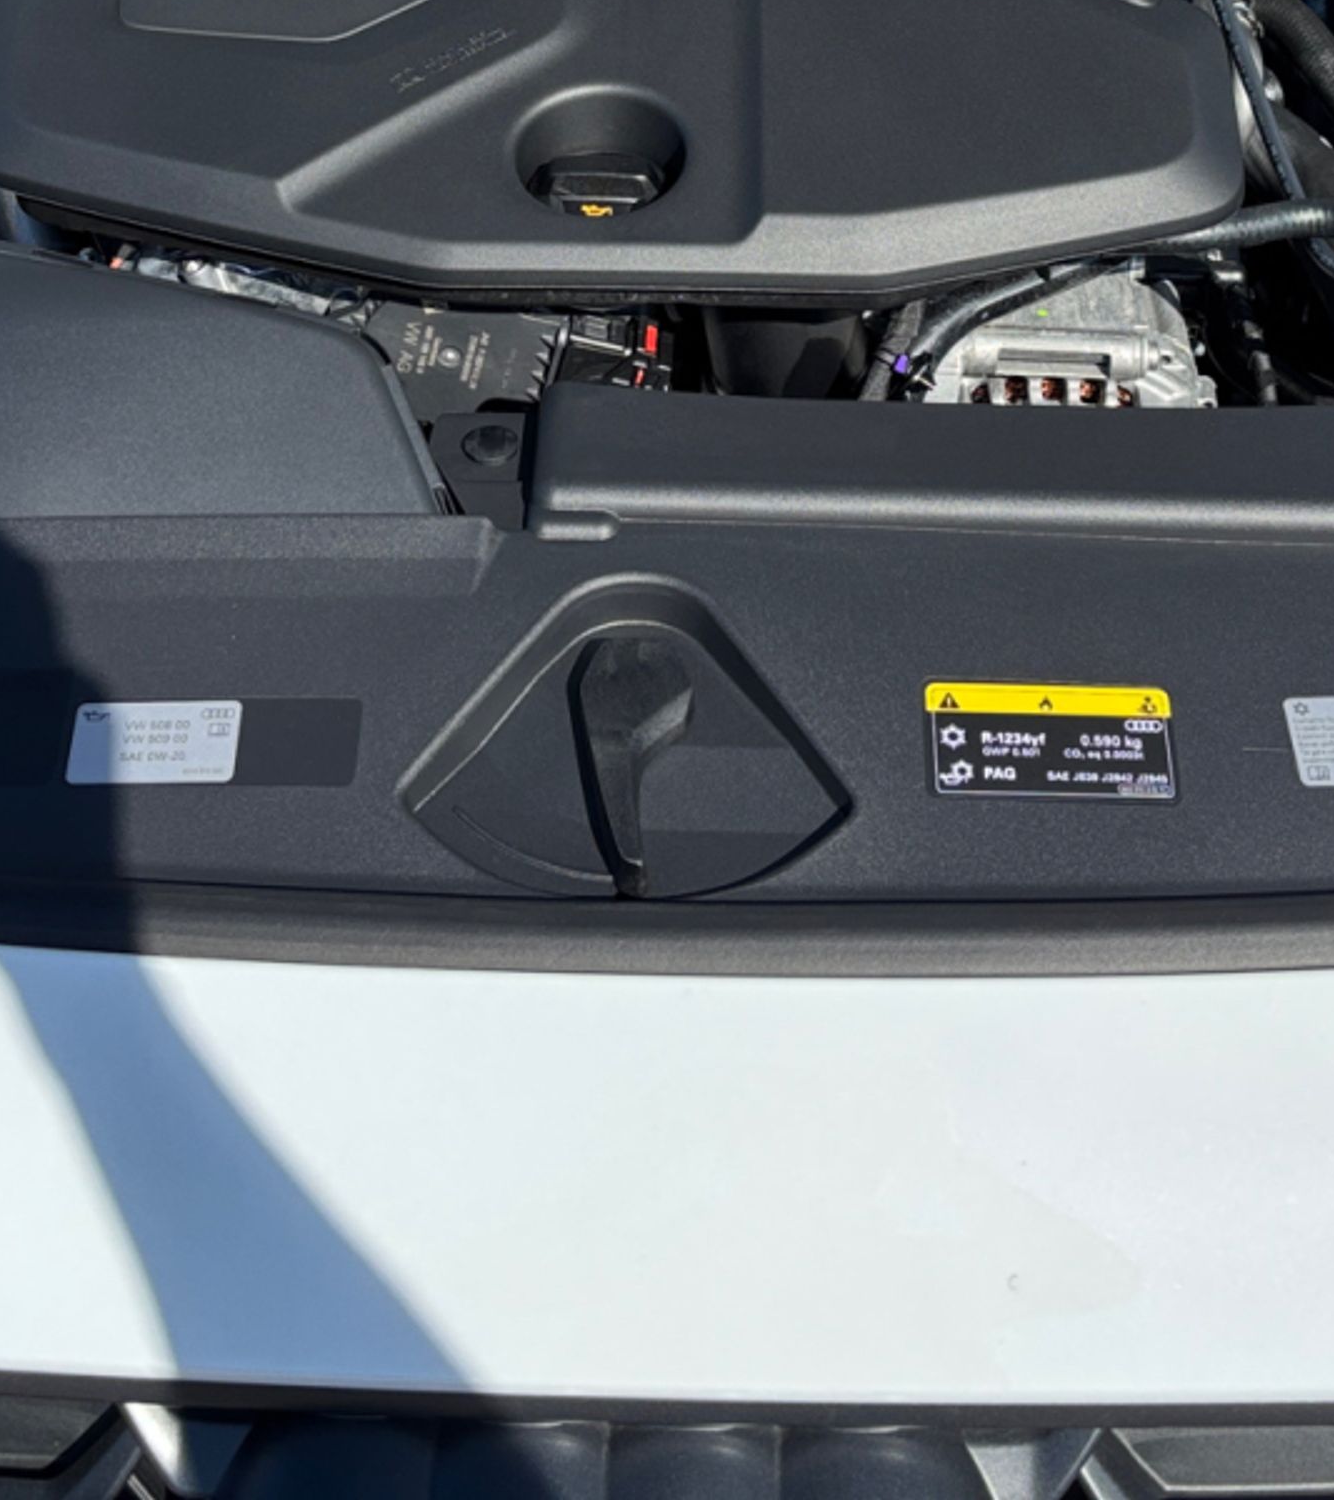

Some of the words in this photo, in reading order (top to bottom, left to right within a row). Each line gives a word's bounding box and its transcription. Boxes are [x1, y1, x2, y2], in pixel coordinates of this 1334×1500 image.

[403, 322, 422, 346] VW
[397, 350, 413, 374] AG
[123, 720, 146, 730] VW
[174, 719, 191, 730] 00
[123, 733, 145, 744] VW
[172, 733, 189, 744] 00
[981, 731, 1046, 747] R-1234yf
[1079, 733, 1121, 748] 0.590
[1124, 735, 1143, 751] kg
[984, 765, 1016, 781] PAG
[1046, 771, 1069, 782] SAE
